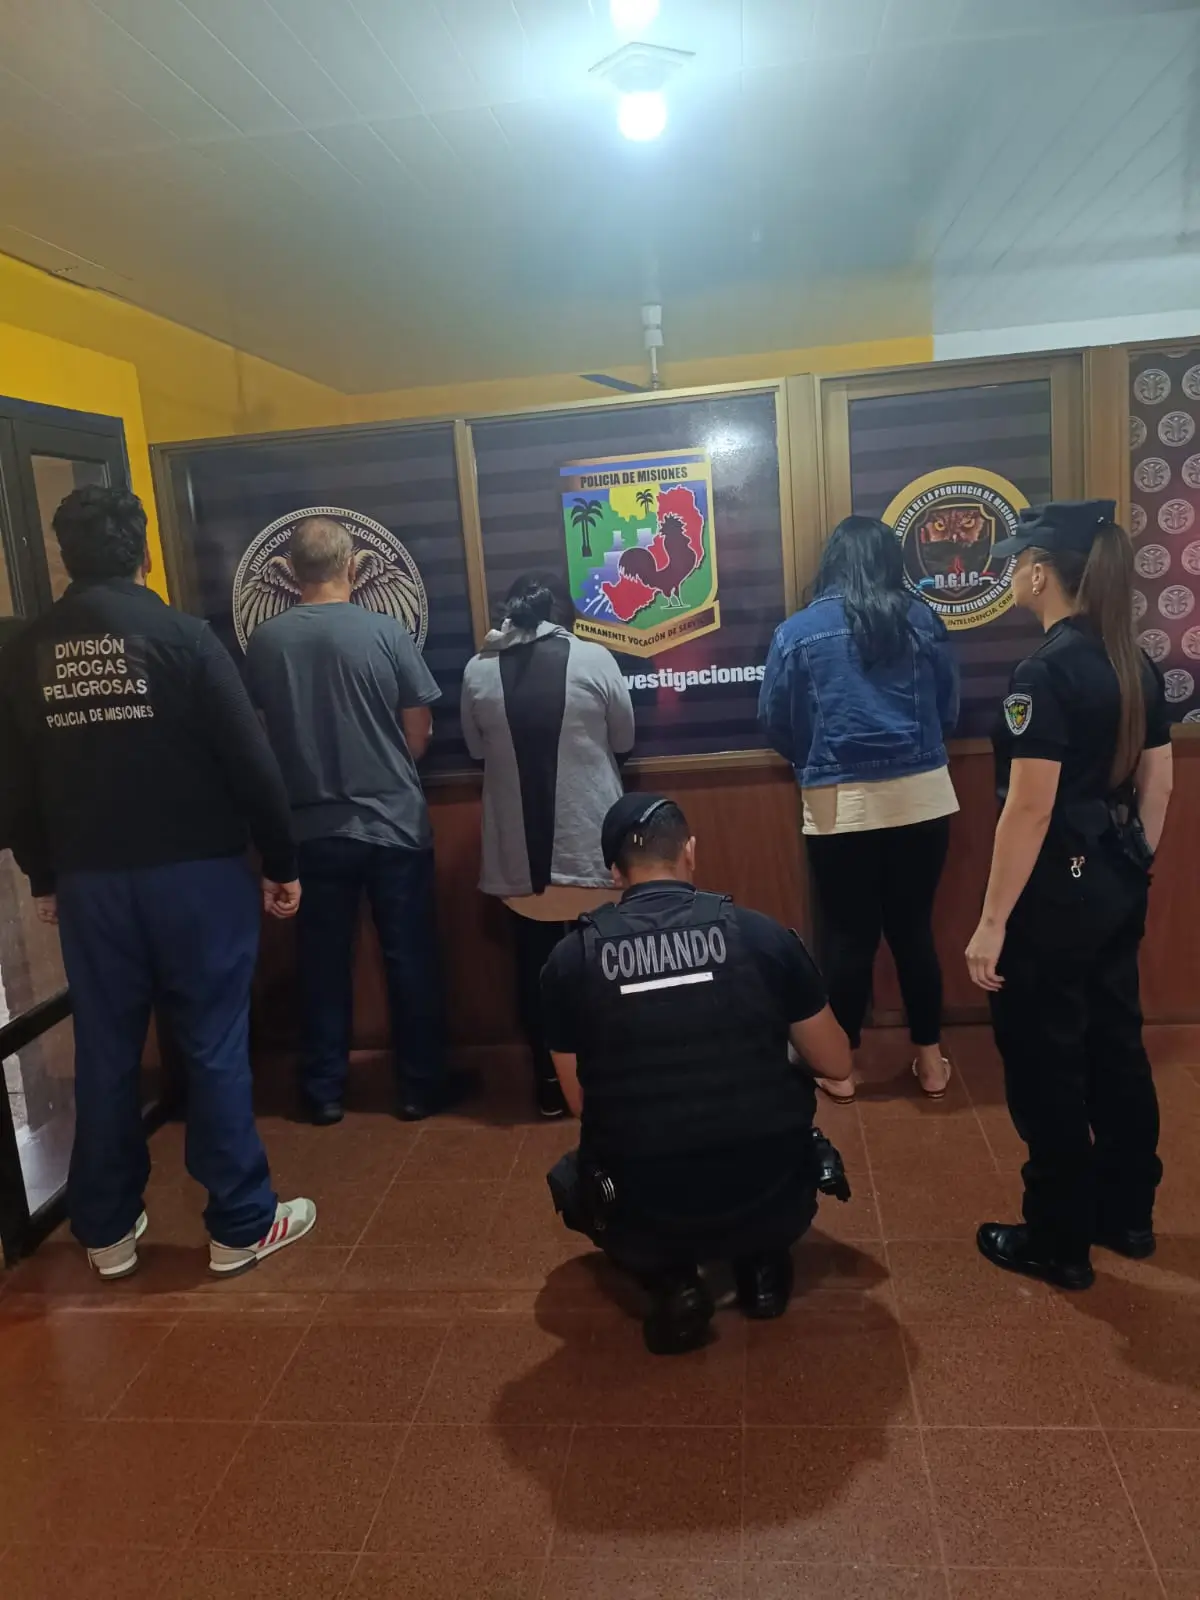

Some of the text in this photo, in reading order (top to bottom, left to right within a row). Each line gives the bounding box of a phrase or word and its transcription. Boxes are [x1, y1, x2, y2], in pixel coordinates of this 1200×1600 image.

[580, 466, 688, 489] POLICIA DE MISIONES
[895, 508, 916, 541] OLICIA
[911, 498, 925, 512] DE
[922, 492, 935, 503] LA
[934, 485, 983, 499] PROVINCIA
[982, 490, 996, 502] DE
[250, 521, 399, 573] DIRECCION ELIGROSAS
[952, 584, 1004, 613] INTELIGENCIA
[999, 554, 1018, 588] CRIMIN
[947, 606, 999, 627] INTELIGENCIA
[54, 633, 125, 659] DIVISIÓN
[575, 622, 627, 642] PERMANENTE
[627, 630, 666, 647] VOCACIÓN
[667, 627, 678, 638] DE
[55, 658, 128, 679] DROGAS
[622, 665, 767, 692] vestigaciones
[43, 679, 148, 702] PELIGROSAS
[46, 705, 155, 728] POLICIA DE MISIONES
[601, 926, 727, 981] COMANDO
